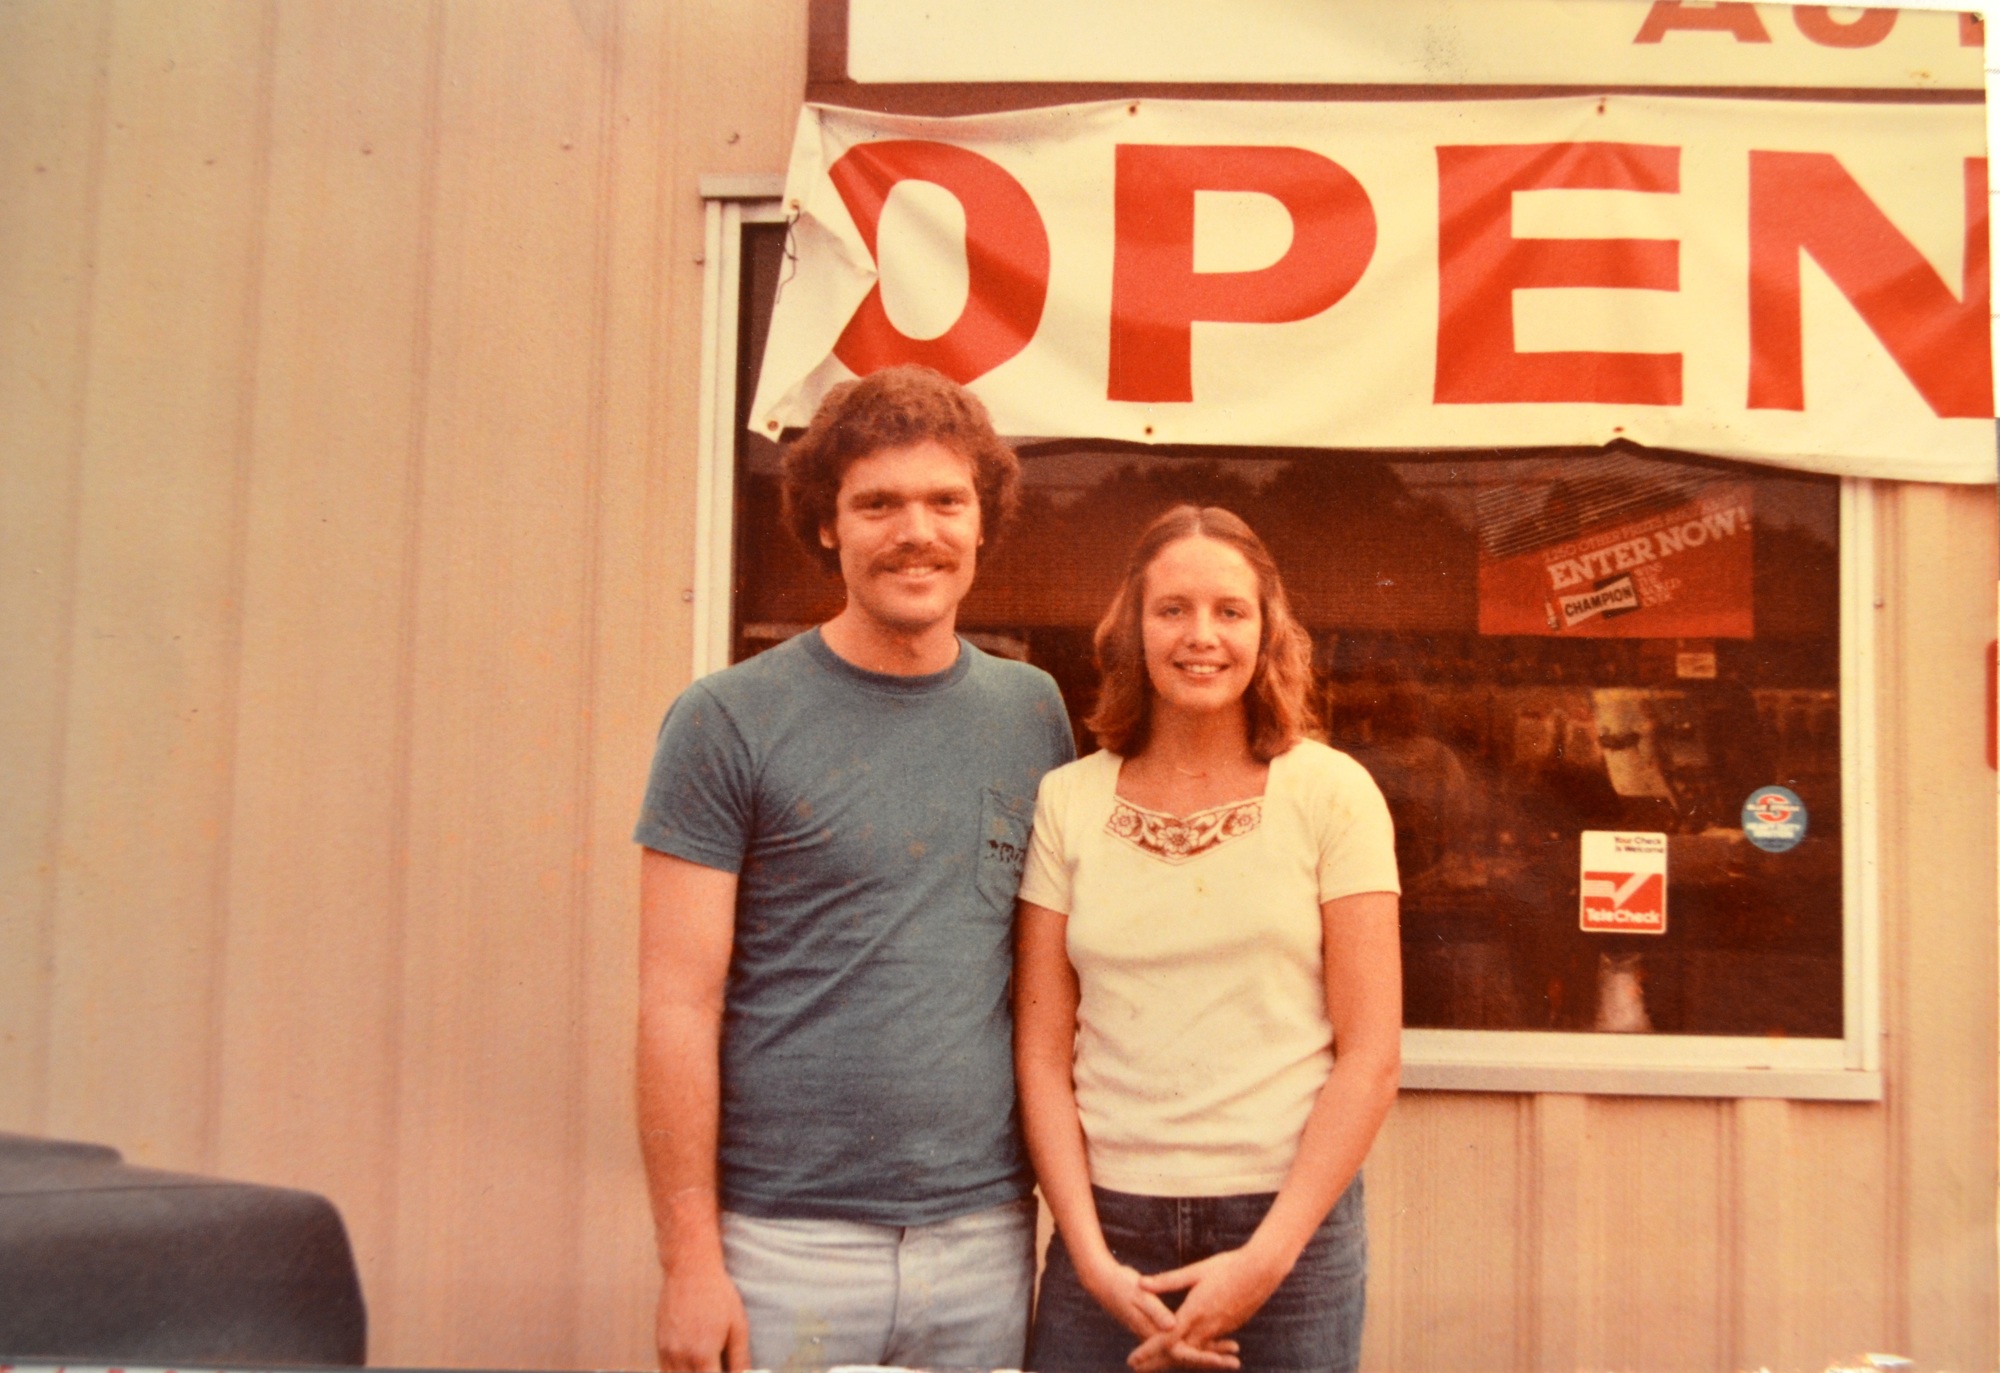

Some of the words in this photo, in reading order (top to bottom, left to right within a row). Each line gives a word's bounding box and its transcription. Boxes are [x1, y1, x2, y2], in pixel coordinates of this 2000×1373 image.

[828, 138, 1994, 420] OPEN
[1547, 536, 1657, 591] ENTER
[1654, 505, 1751, 558] NOW!
[1564, 585, 1634, 617] CHAMPION
[1614, 836, 1632, 844] Your
[1634, 836, 1662, 845] Check
[1624, 845, 1664, 854] Welcome
[1586, 907, 1660, 924] TeleCheck
